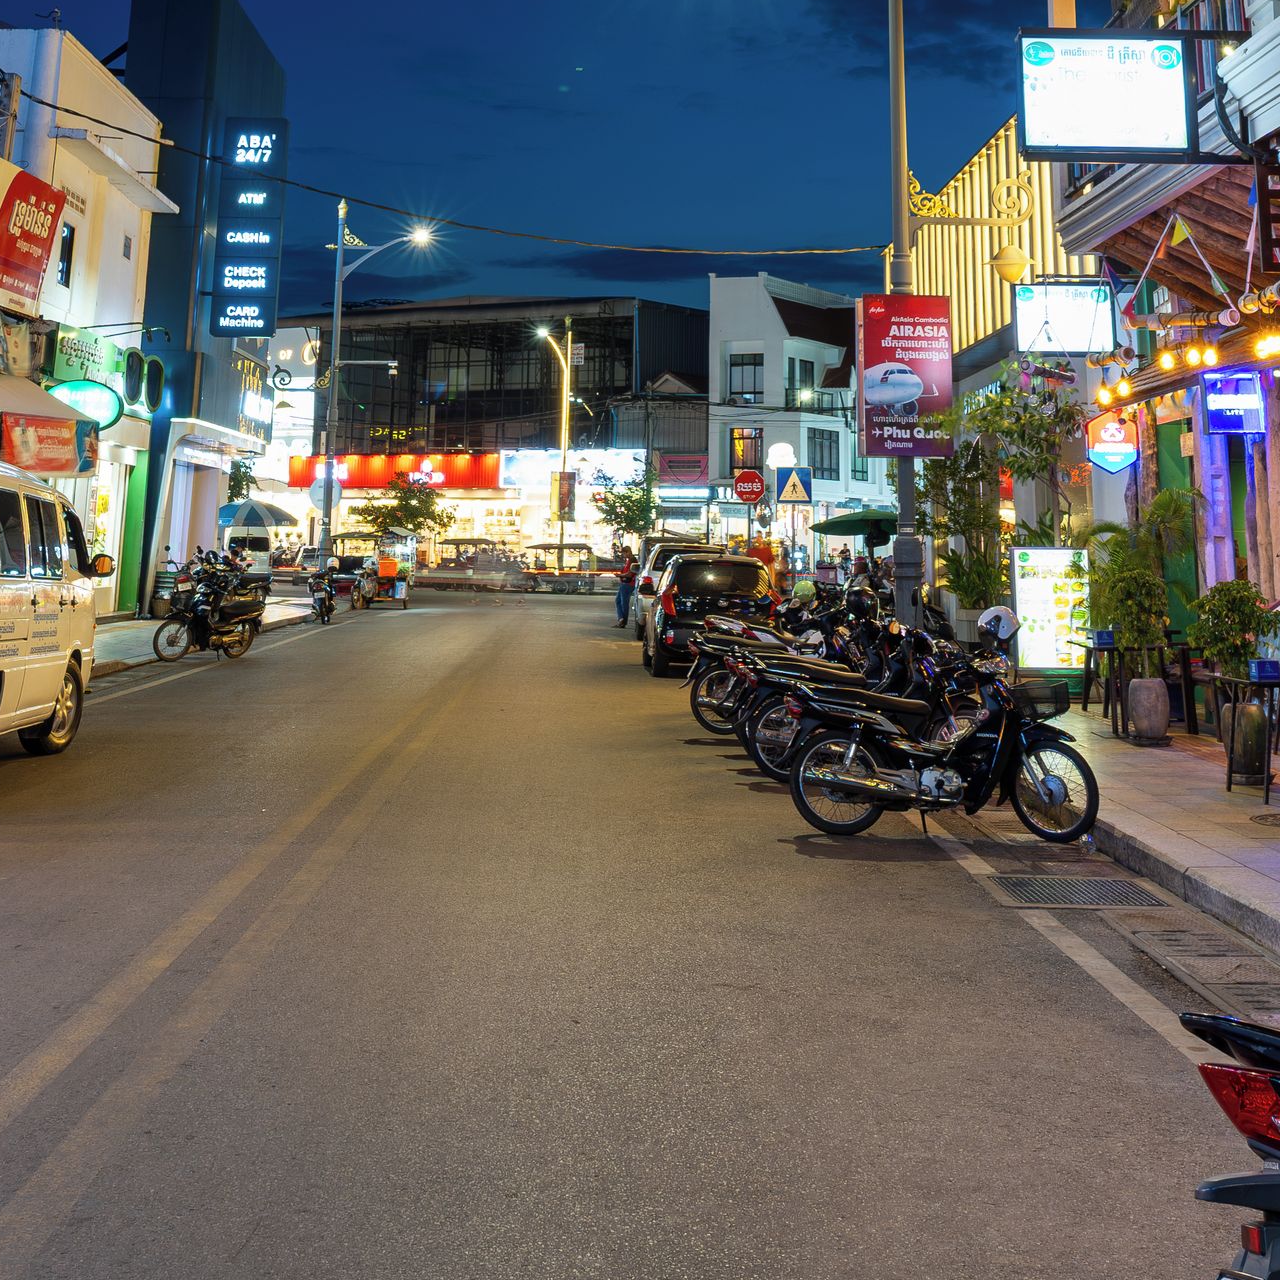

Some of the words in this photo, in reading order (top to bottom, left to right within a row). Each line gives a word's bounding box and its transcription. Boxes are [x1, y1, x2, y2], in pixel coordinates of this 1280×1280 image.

[237, 134, 272, 148] ABA
[235, 148, 272, 162] 24/7
[238, 193, 264, 204] ATM
[226, 232, 259, 243] CASH
[224, 266, 267, 277] CHECK
[223, 277, 266, 289] Deposit
[226, 306, 259, 317] CARD
[219, 317, 264, 328] Machine
[914, 316, 949, 324] Cambodia
[889, 325, 949, 337] AIRASIA
[883, 427, 911, 439] Phu
[736, 478, 762, 492] ឈប់
